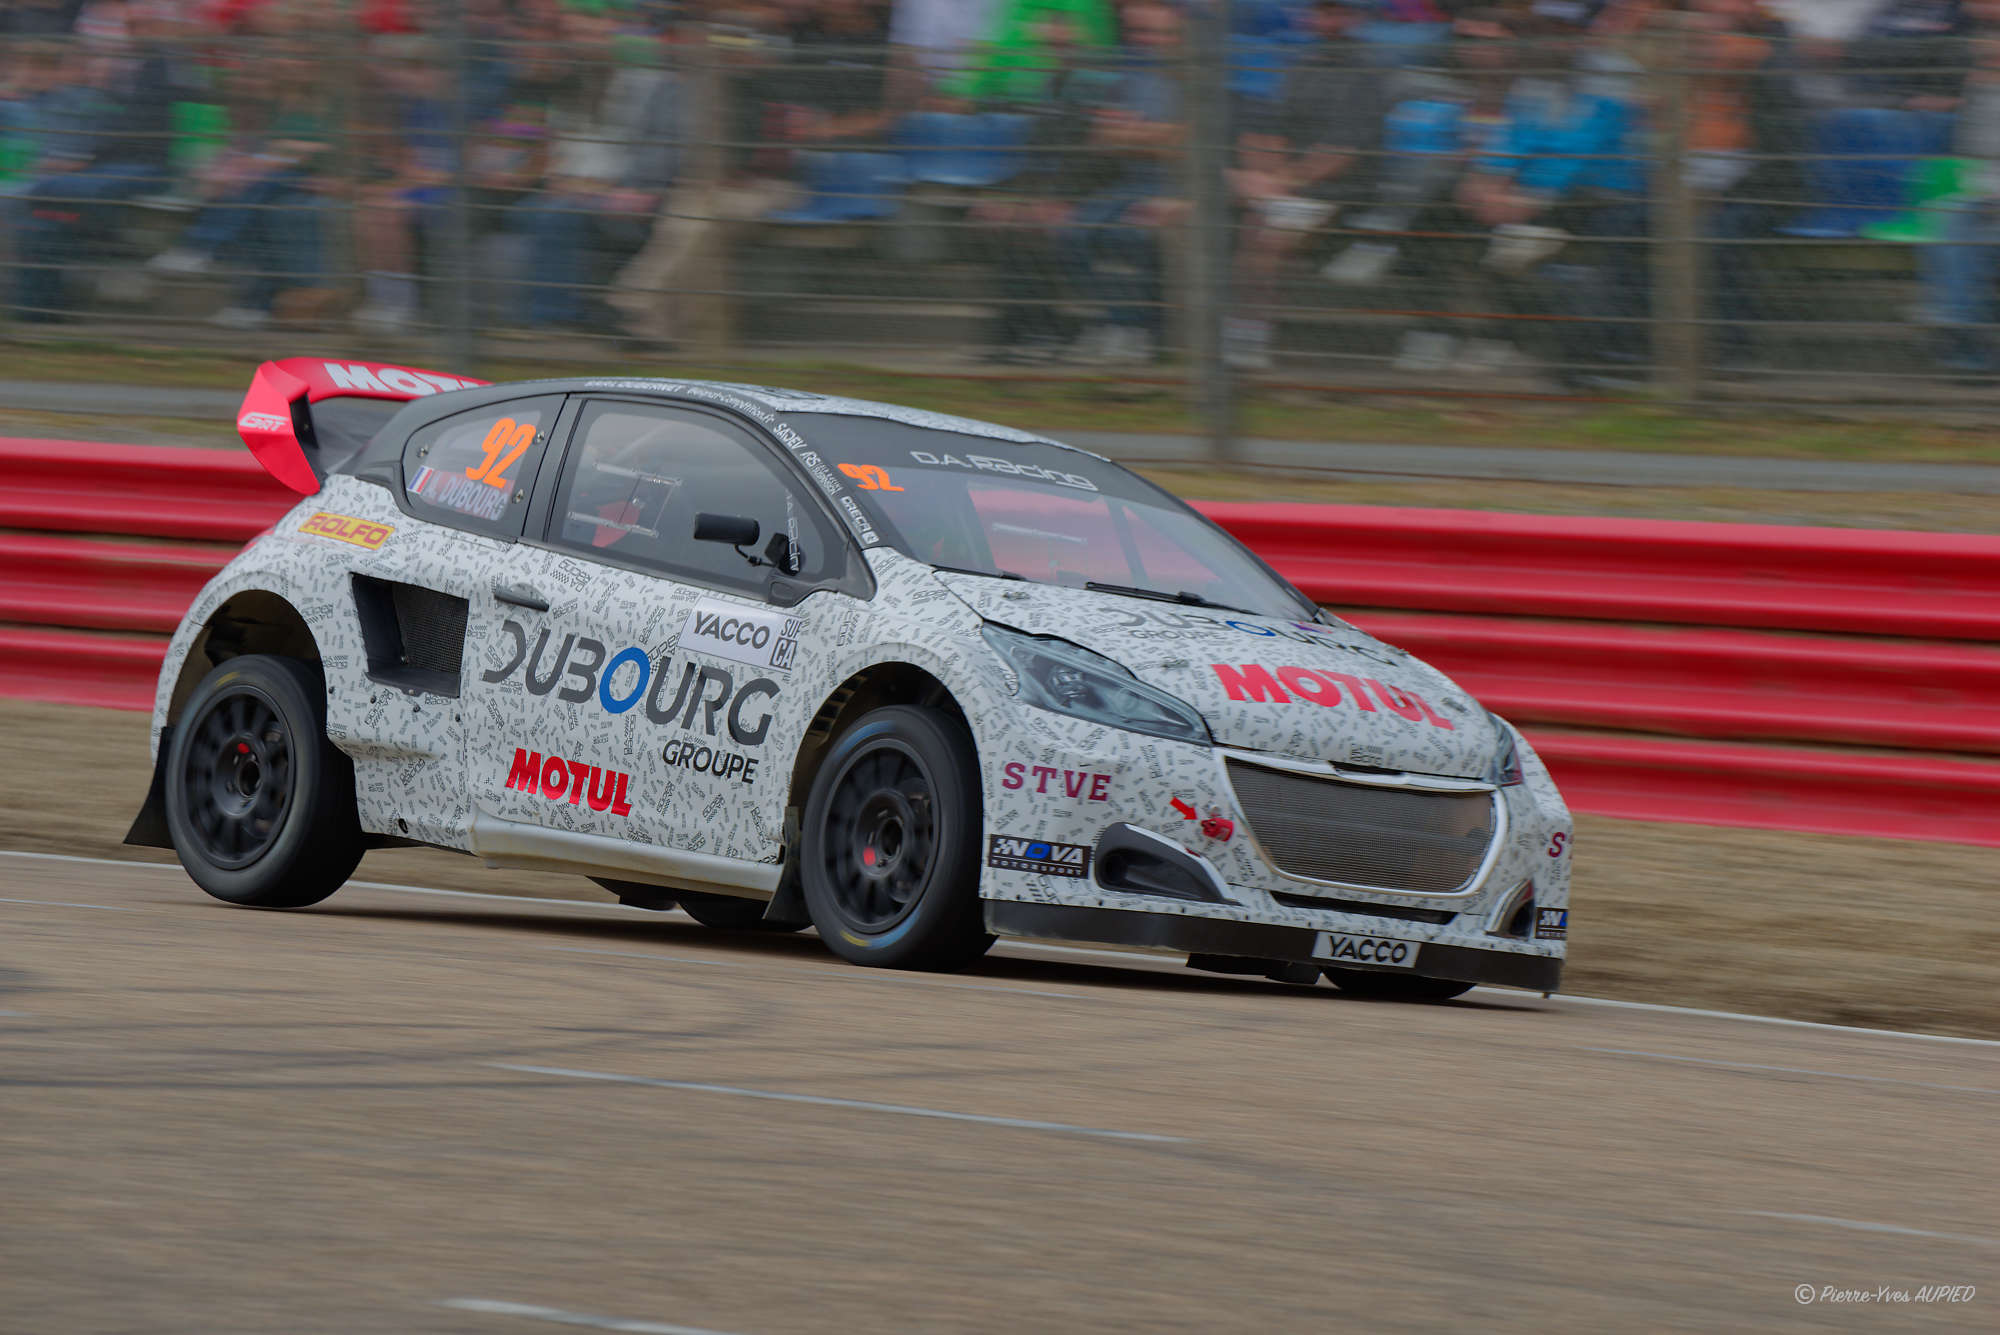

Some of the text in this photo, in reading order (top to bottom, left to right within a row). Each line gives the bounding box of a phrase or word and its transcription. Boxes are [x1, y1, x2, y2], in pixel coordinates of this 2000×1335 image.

[323, 361, 482, 394] MOT
[465, 416, 537, 489] 92
[837, 463, 905, 492] 92
[302, 514, 388, 549] ROLFO
[693, 610, 771, 650] YACCO
[481, 619, 782, 747] DUBOURG
[1210, 663, 1456, 732] MOTUL
[504, 747, 633, 818] MOTUL
[662, 739, 760, 785] GROUPE
[1001, 761, 1113, 802] STVE
[1328, 935, 1408, 964] YACCO
